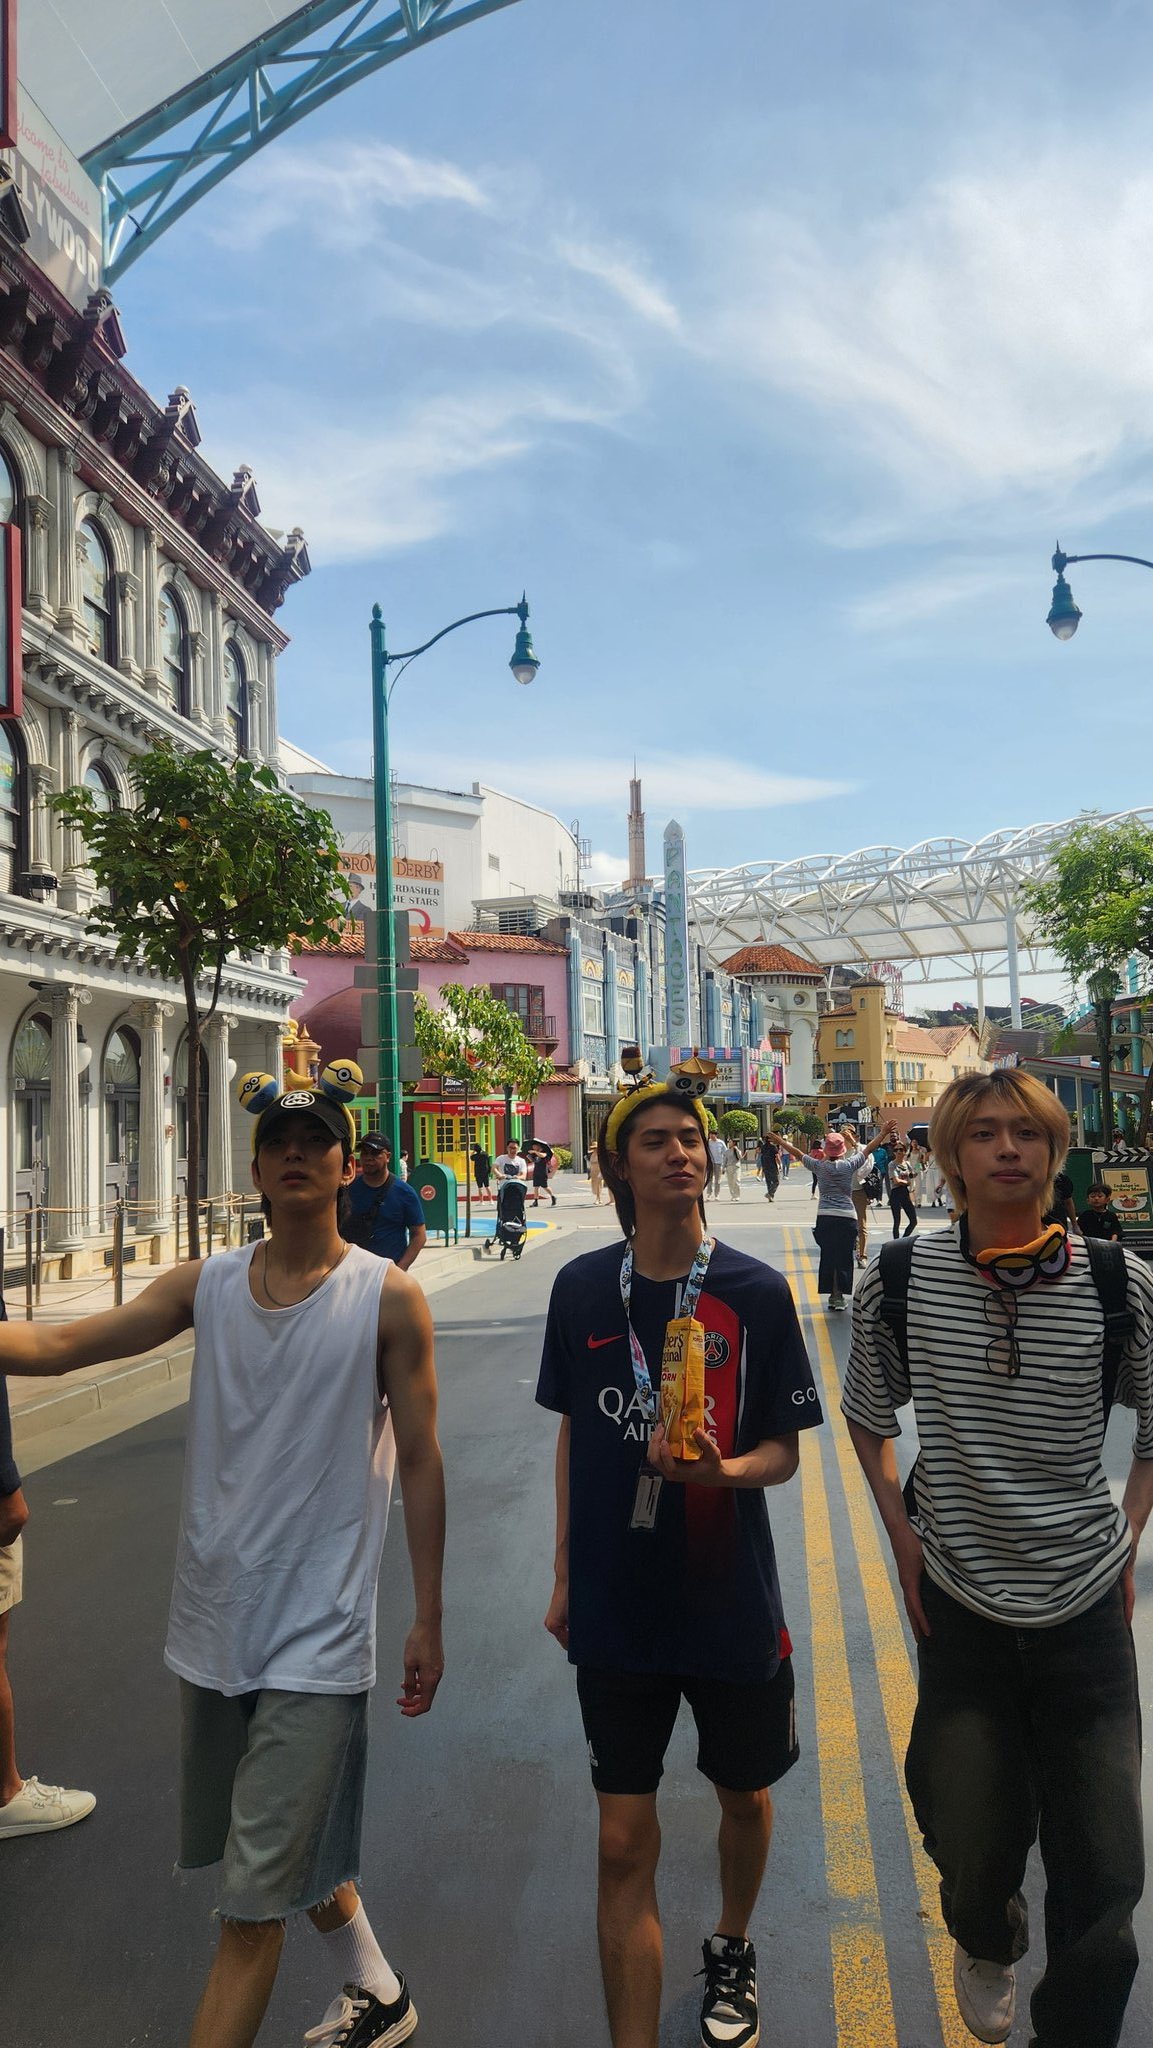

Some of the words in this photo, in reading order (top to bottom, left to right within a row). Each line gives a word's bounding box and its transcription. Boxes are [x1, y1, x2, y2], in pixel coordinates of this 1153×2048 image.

[17, 112, 54, 162] elcome
[57, 144, 69, 174] to
[40, 158, 91, 216] fabulous
[397, 861, 441, 880] DERBY
[370, 881, 440, 897] HRDASHER
[409, 896, 438, 907] STARS
[665, 847, 687, 1027] PANTAGES
[705, 1333, 724, 1343] ARIS
[662, 1348, 682, 1366] ginal
[661, 1373, 677, 1382] ORN
